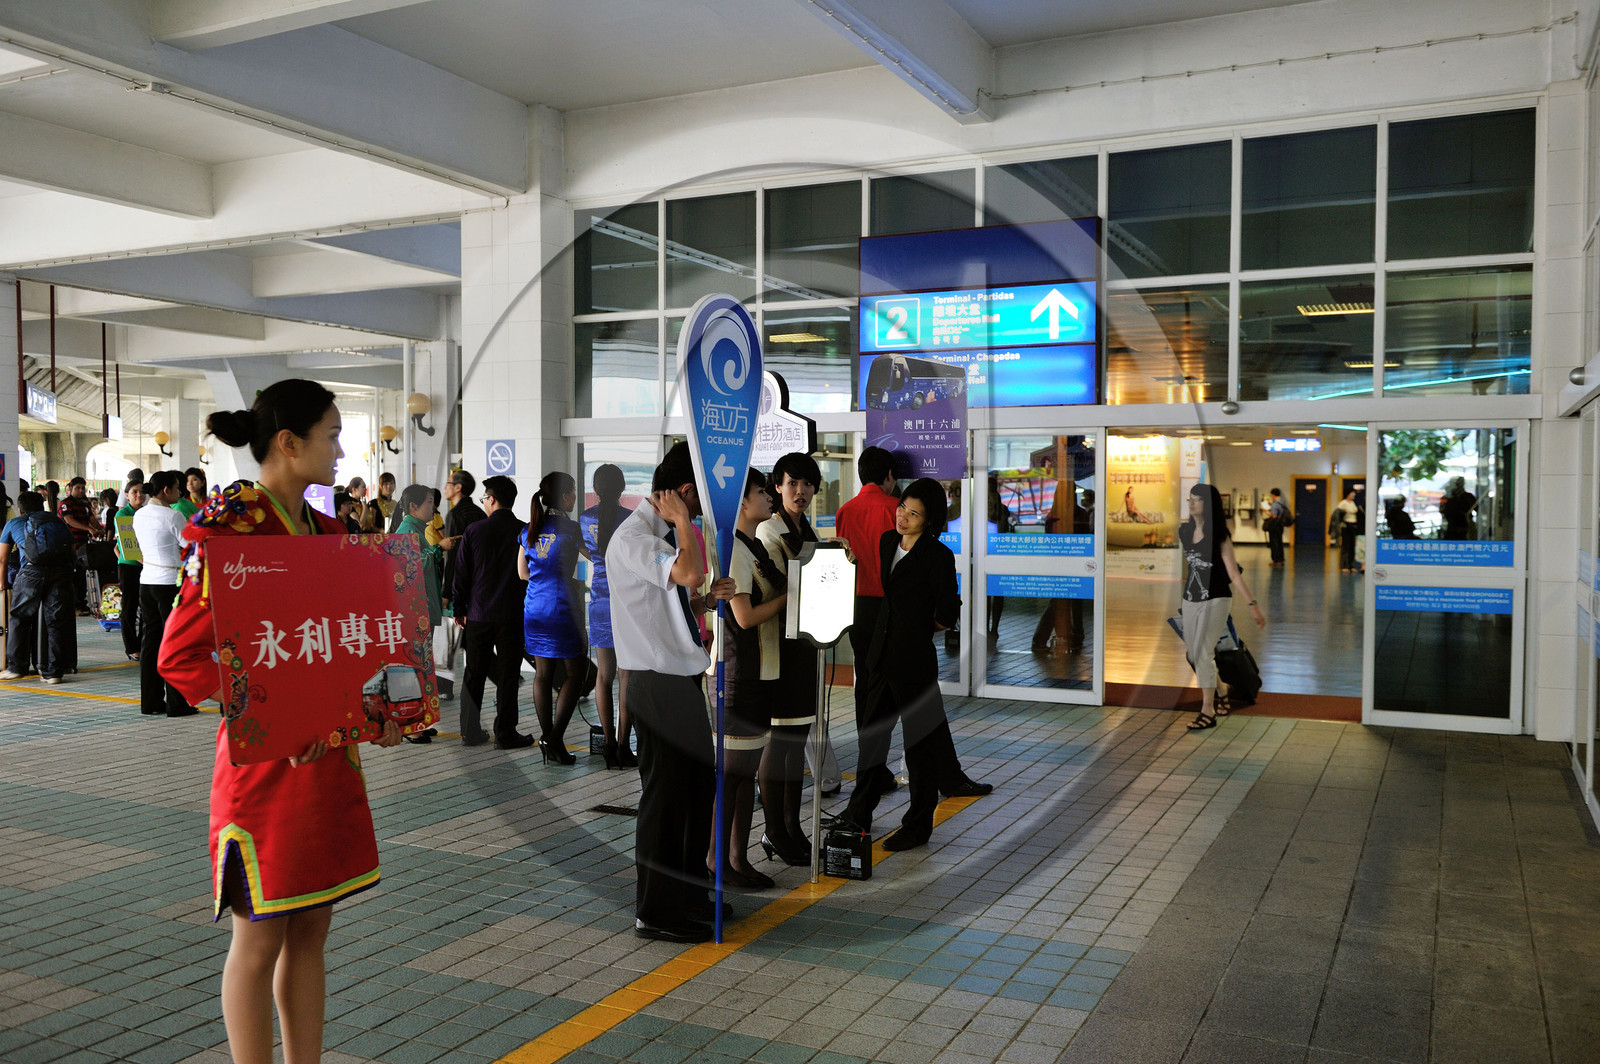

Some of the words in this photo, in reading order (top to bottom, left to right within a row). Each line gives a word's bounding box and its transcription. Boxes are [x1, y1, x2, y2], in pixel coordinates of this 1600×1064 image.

[933, 295, 971, 304] Terminal
[977, 292, 1014, 301] Partidas
[886, 306, 908, 340] 2
[982, 314, 1000, 323] Hall
[933, 354, 970, 363] Terminal
[976, 352, 1021, 362] Chegadas
[968, 376, 986, 384] Hall
[702, 398, 749, 433] 海立方
[904, 418, 961, 430] 澳門十六浦
[755, 421, 801, 442] 桂坊酒店
[707, 435, 744, 446] OCEANUS
[923, 458, 936, 468] MJ
[250, 610, 408, 669] 永利專車
[827, 845, 852, 854] Panasonic
